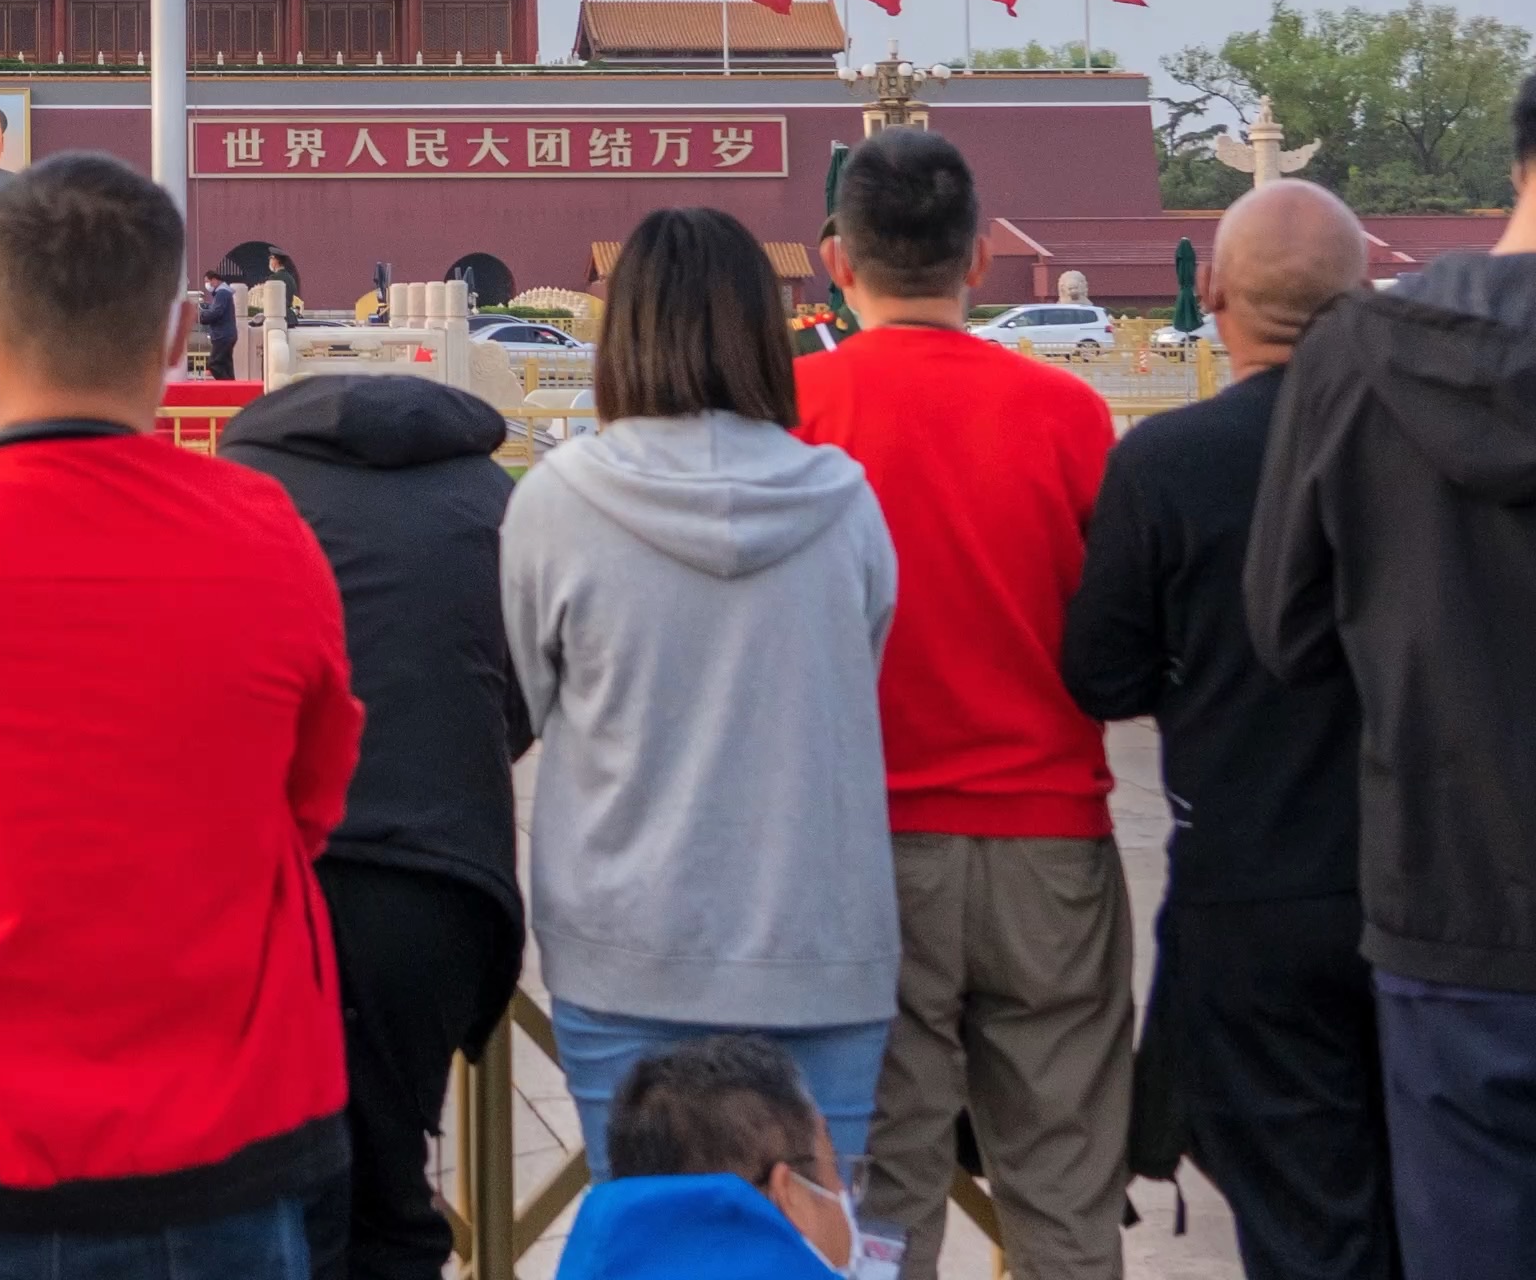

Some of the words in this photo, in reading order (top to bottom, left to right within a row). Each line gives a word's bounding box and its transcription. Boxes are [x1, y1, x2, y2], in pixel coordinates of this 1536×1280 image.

[222, 127, 755, 168] 世界人民大团结万岁
